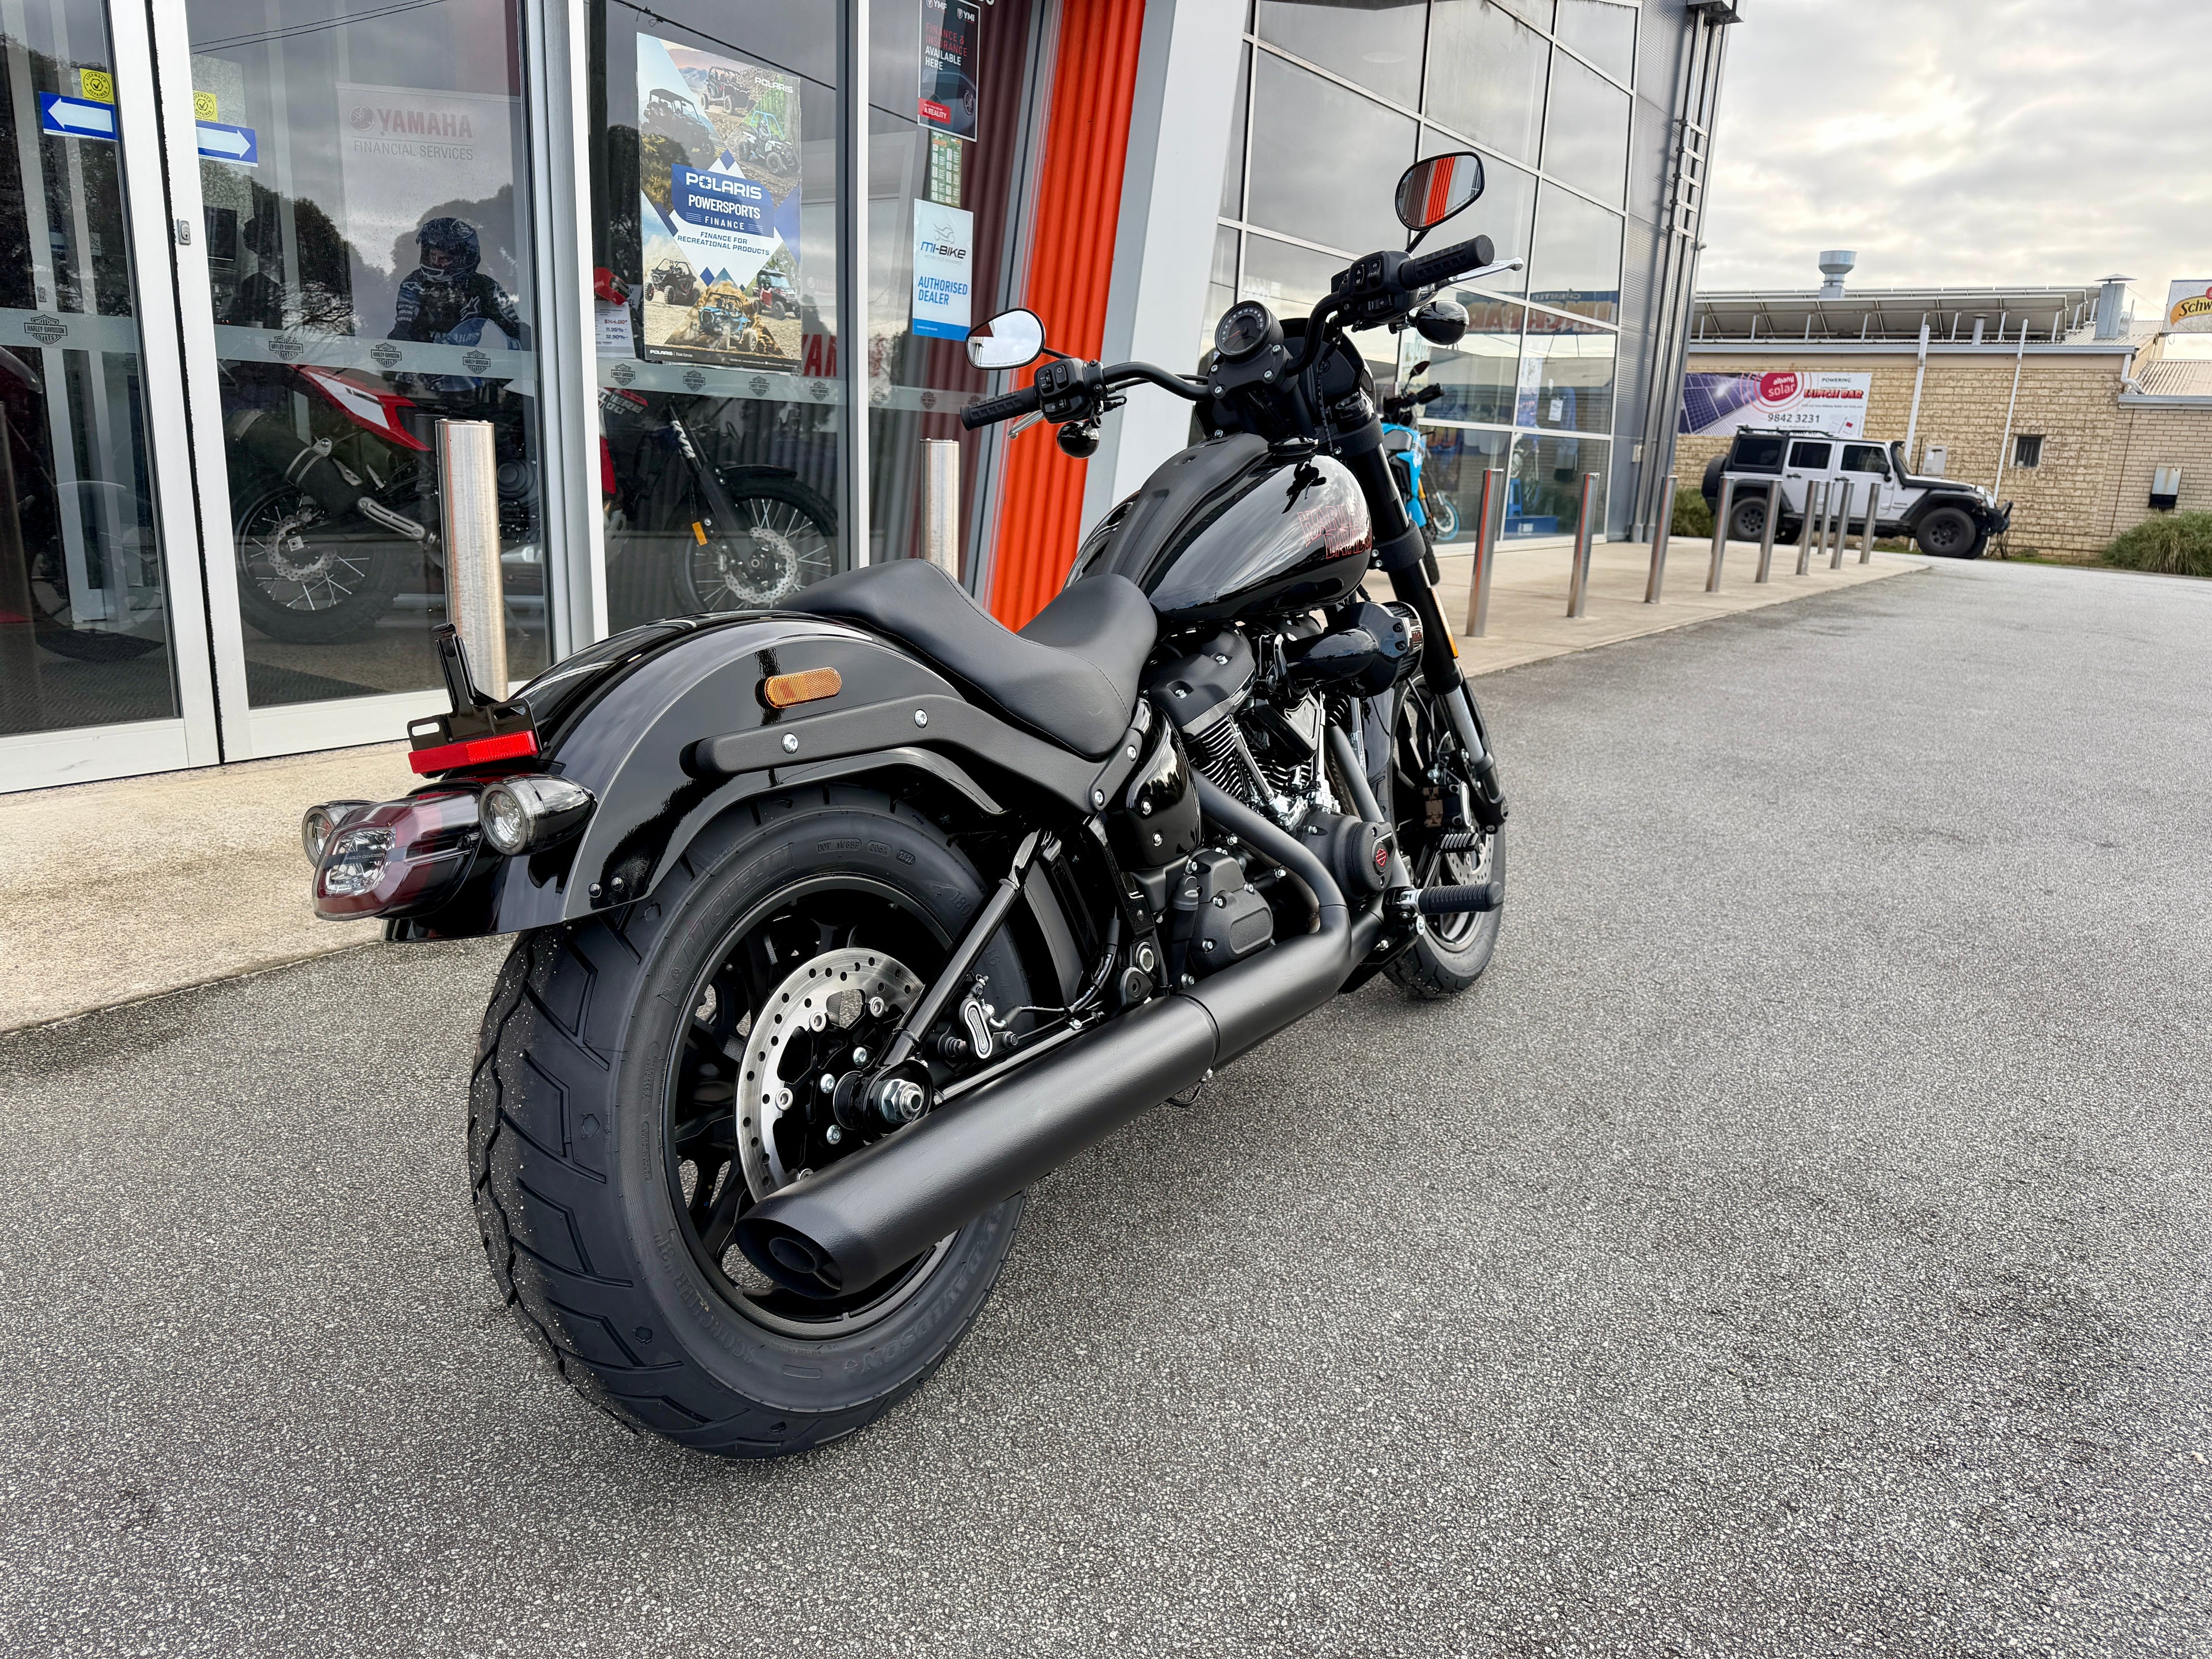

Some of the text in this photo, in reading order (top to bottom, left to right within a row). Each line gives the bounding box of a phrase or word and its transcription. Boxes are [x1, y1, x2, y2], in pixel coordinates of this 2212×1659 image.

[963, 11, 975, 22] YMI
[926, 23, 965, 45] FINANCE &
[926, 35, 967, 56] INSURANCE
[925, 45, 961, 66] AVAILABLE
[925, 56, 943, 70] HERE
[85, 72, 107, 84] LICENSED
[755, 77, 793, 93] POLARIS
[928, 108, 947, 119] REALITY
[377, 108, 473, 138] YAMAHA
[354, 142, 474, 161] FINANCIAL SERVICES
[685, 172, 762, 200] POLARIS
[688, 194, 760, 219] POWERSPORTS
[704, 215, 745, 230] FINANCE
[677, 235, 770, 256] RECREATIONAL PRODUCTS
[700, 232, 748, 245] FINANCE FOR
[918, 275, 968, 296] AUTHORISED
[918, 289, 949, 305] DEALER
[26, 325, 65, 334] HARLEY-DAVIDSON
[650, 349, 673, 357] POLARIS
[1772, 375, 1794, 386] albany
[1768, 383, 1796, 397] solar
[1804, 389, 1863, 399] LUNCH BAR
[1767, 413, 1820, 423] 9842 3231
[1297, 501, 1367, 548] HARLEY
[817, 842, 831, 851] DOT
[683, 846, 792, 964] MICHELIN
